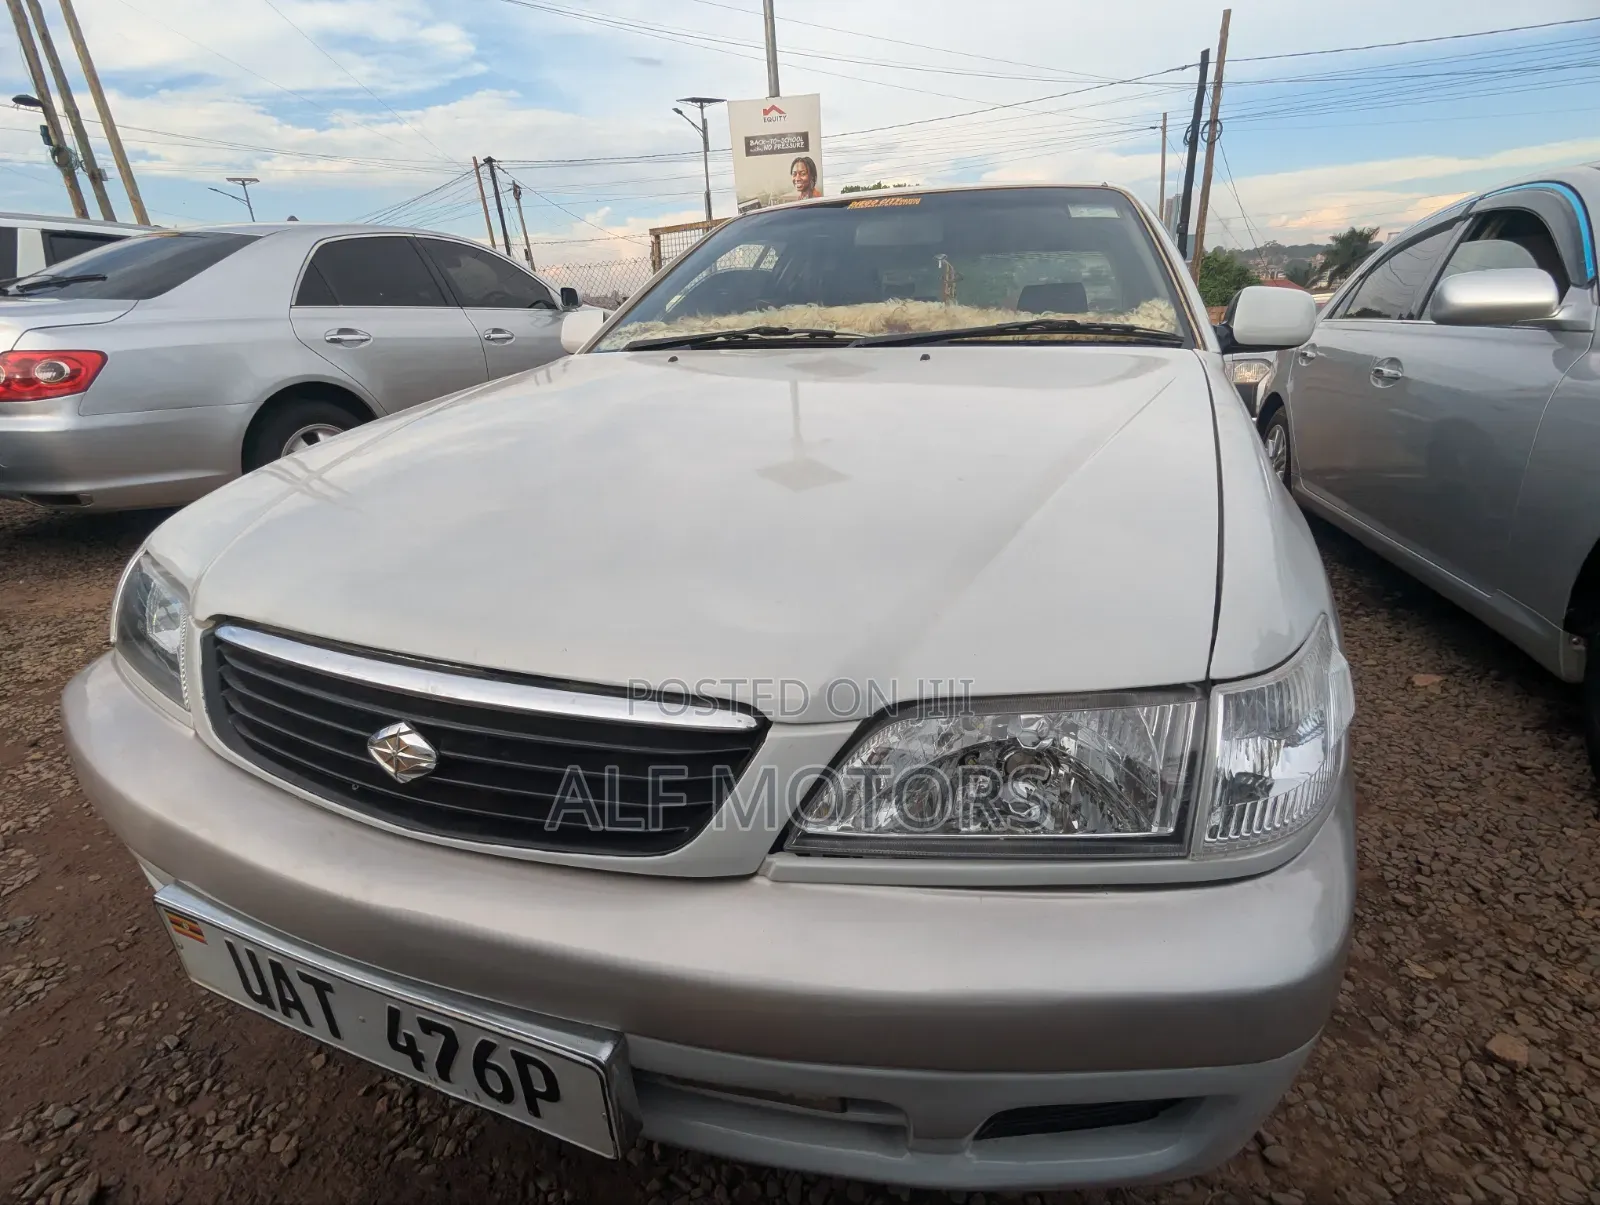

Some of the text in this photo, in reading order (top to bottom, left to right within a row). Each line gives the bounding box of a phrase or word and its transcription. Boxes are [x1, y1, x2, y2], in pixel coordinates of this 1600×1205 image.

[763, 115, 788, 123] EQUITY
[749, 136, 804, 147] BACK-TO-SCHOOL
[773, 141, 805, 151] PRESSURE
[224, 937, 561, 1119] UAT 476P
